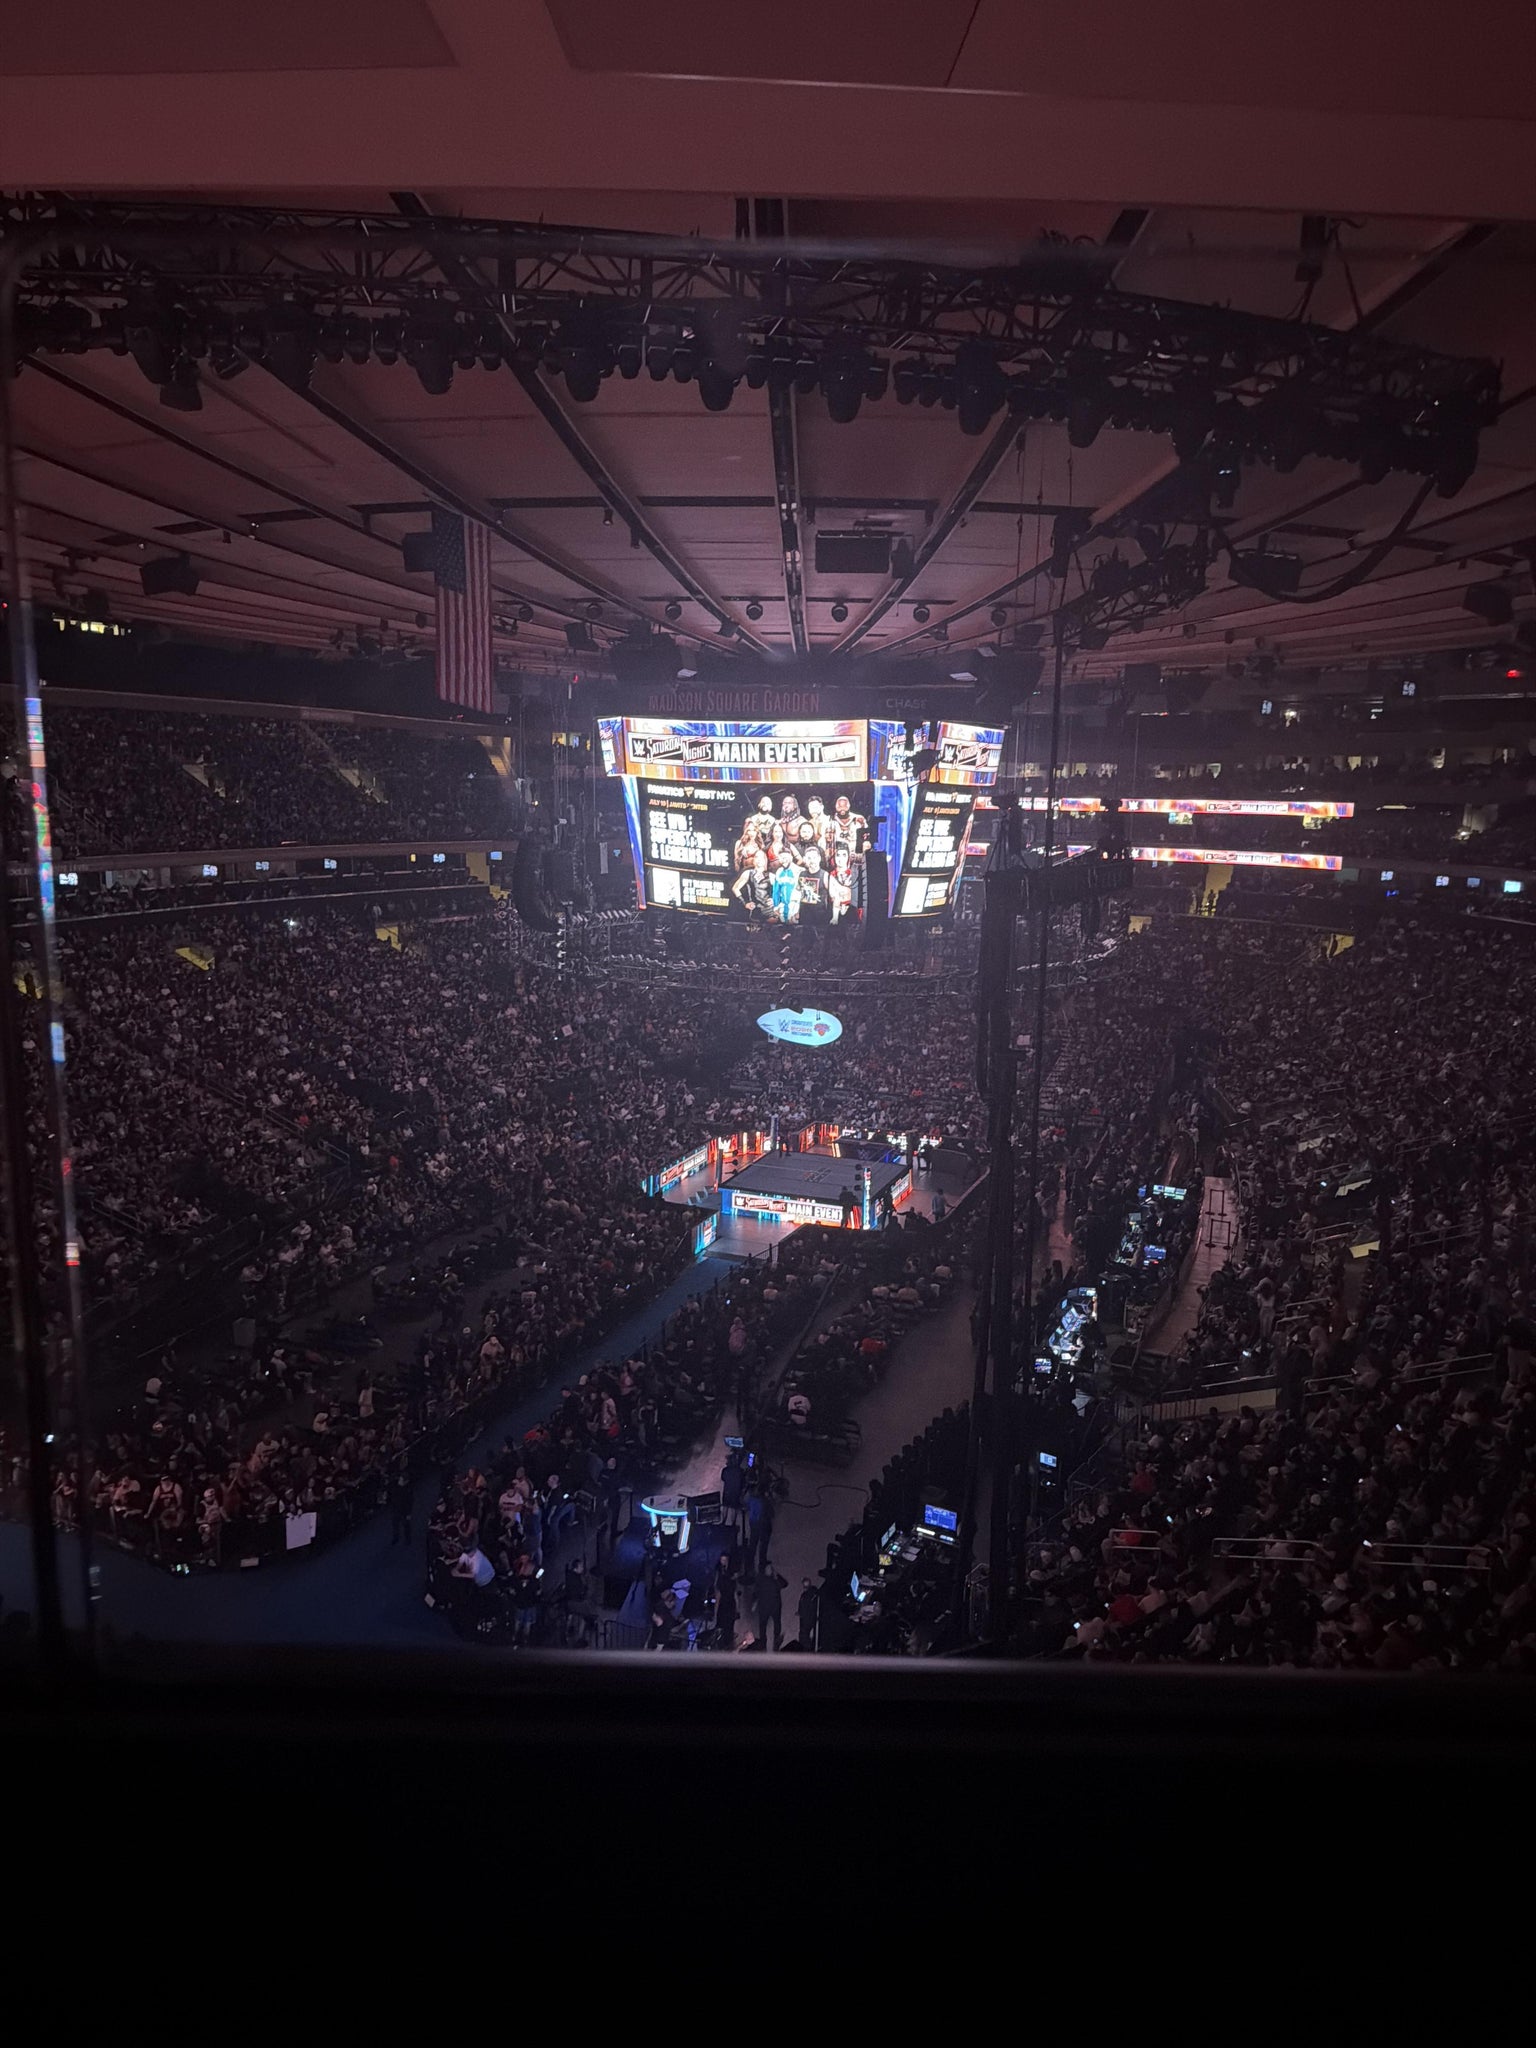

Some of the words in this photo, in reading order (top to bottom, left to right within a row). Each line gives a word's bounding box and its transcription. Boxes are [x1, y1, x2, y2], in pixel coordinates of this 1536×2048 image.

[649, 691, 703, 711] MADISON
[707, 691, 757, 712] SQUARE
[764, 690, 820, 712] GARDEN
[885, 697, 929, 709] CHASE
[714, 743, 760, 762] MAIN
[764, 743, 822, 763] EVENT
[694, 789, 716, 800] FEST
[716, 791, 735, 801] NYC
[650, 811, 667, 829] SEE
[705, 849, 729, 867] LIVE
[787, 1203, 813, 1217] MAIN
[814, 1206, 843, 1220] EVENT
